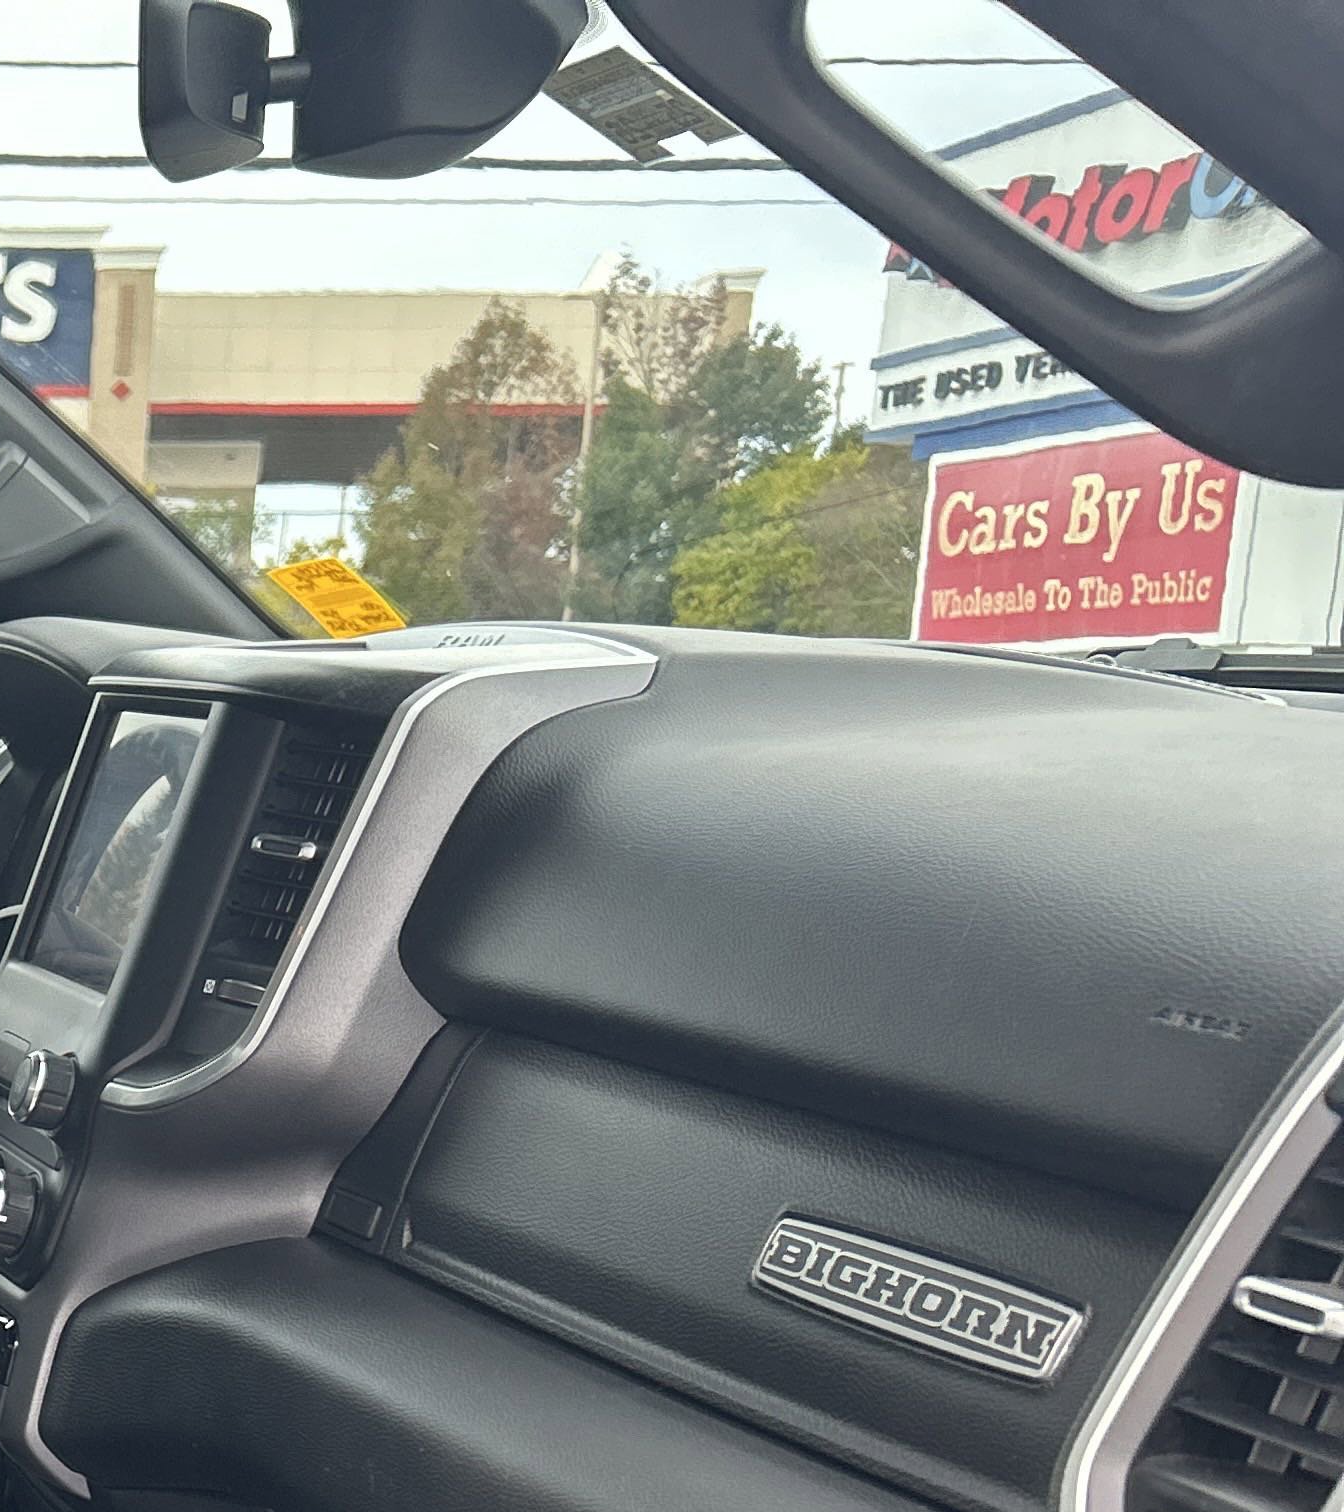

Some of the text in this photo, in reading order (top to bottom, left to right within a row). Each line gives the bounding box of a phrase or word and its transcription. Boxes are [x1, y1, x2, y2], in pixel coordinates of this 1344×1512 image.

[879, 376, 926, 409] THE
[934, 361, 1004, 399] USED
[937, 458, 1226, 562] Cars By Us
[930, 568, 1213, 620] Wholesale To The Public
[761, 1230, 1064, 1364] BIGHORN
